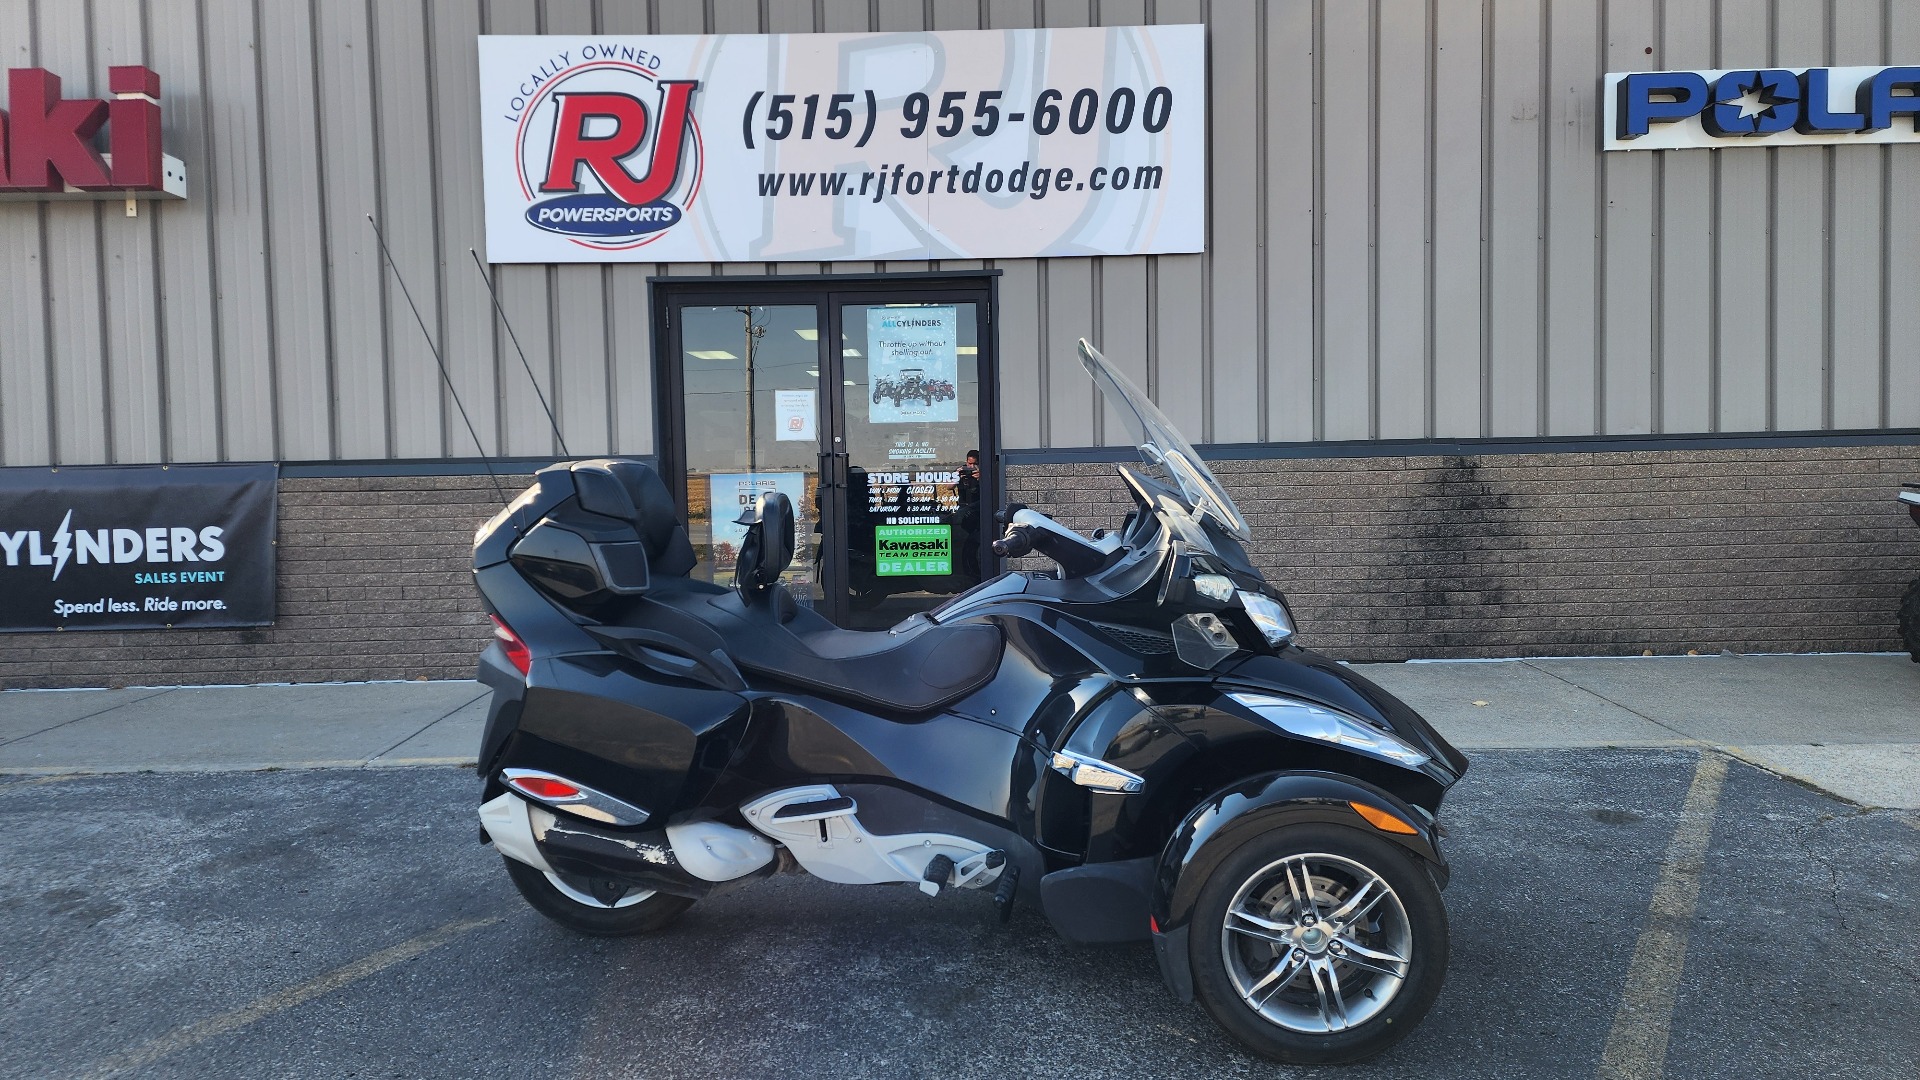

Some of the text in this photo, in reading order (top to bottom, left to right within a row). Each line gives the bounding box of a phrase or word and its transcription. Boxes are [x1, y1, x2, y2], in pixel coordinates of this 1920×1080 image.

[504, 43, 661, 123] LOCALLY OWNED
[742, 86, 1173, 149] (515) 955-6000
[537, 79, 701, 206] RJ
[757, 161, 1163, 203] www.rjfortdodge.com
[538, 206, 673, 223] POWERSPORTS
[879, 340, 906, 348] Throttle
[892, 348, 919, 357] shelling
[867, 472, 960, 484] STORE HOURS
[906, 485, 935, 495] CLOSED
[739, 494, 756, 505] DE
[869, 505, 901, 513] SATURDAY
[898, 516, 940, 524] SOLICITING
[878, 528, 948, 536] AUTHORIZED
[878, 538, 949, 551] Kawasaki
[879, 562, 949, 573] DEALER
[134, 570, 225, 585] SALES EVENT
[53, 596, 227, 618] Spend less. Ride more.
